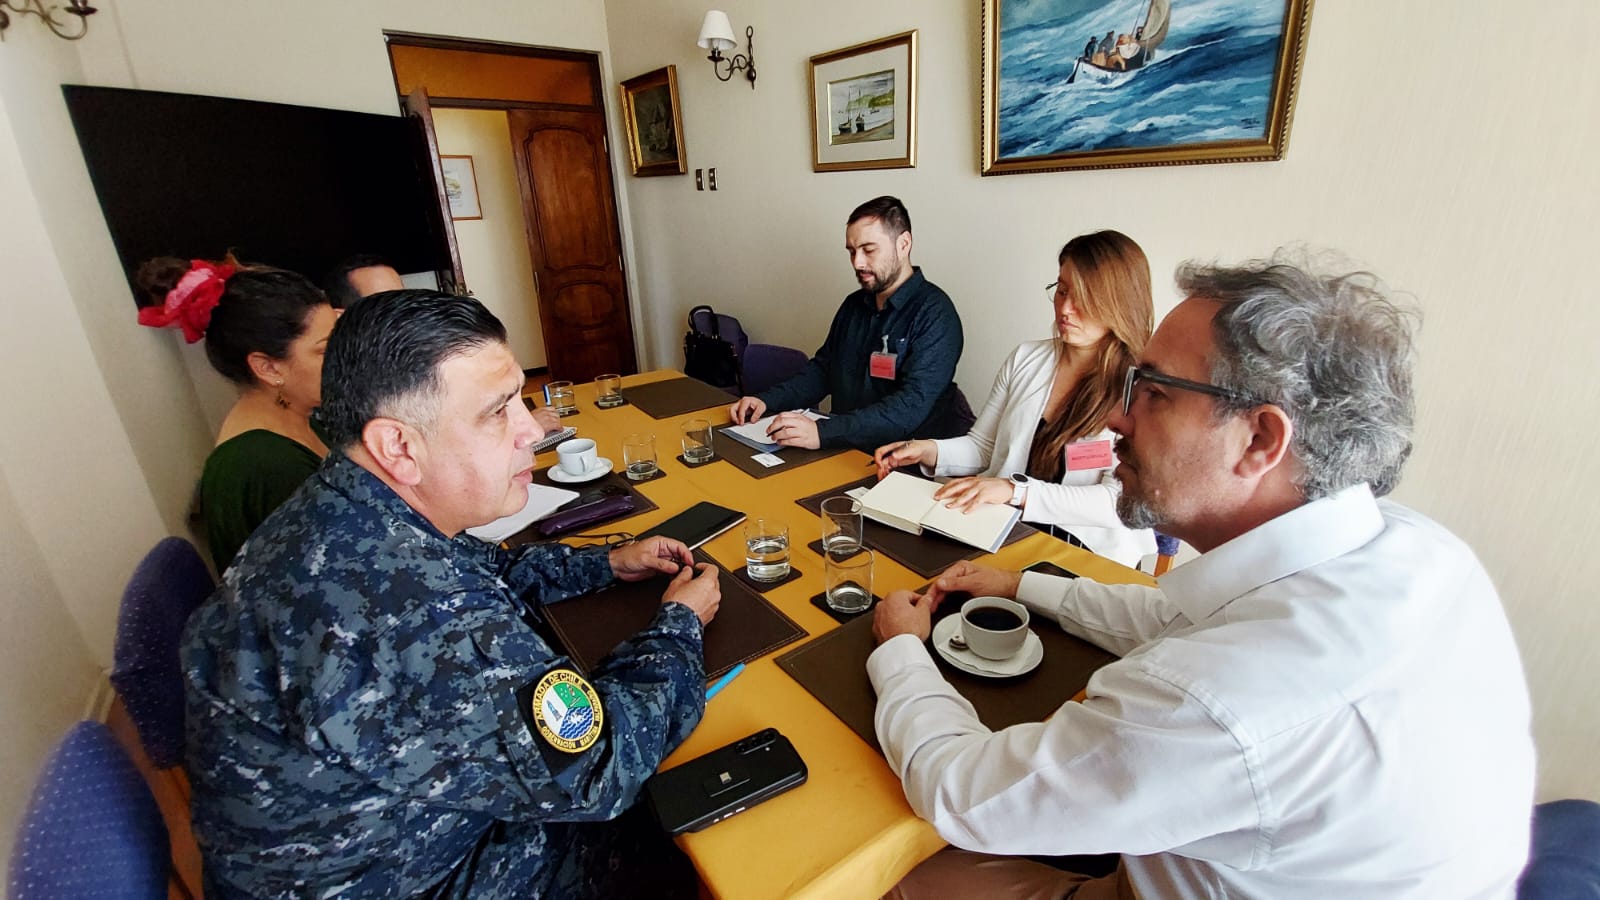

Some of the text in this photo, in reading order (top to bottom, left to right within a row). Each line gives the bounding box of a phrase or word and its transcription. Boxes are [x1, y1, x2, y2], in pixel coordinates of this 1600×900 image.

[535, 673, 583, 720] ARMADA DE CHILE
